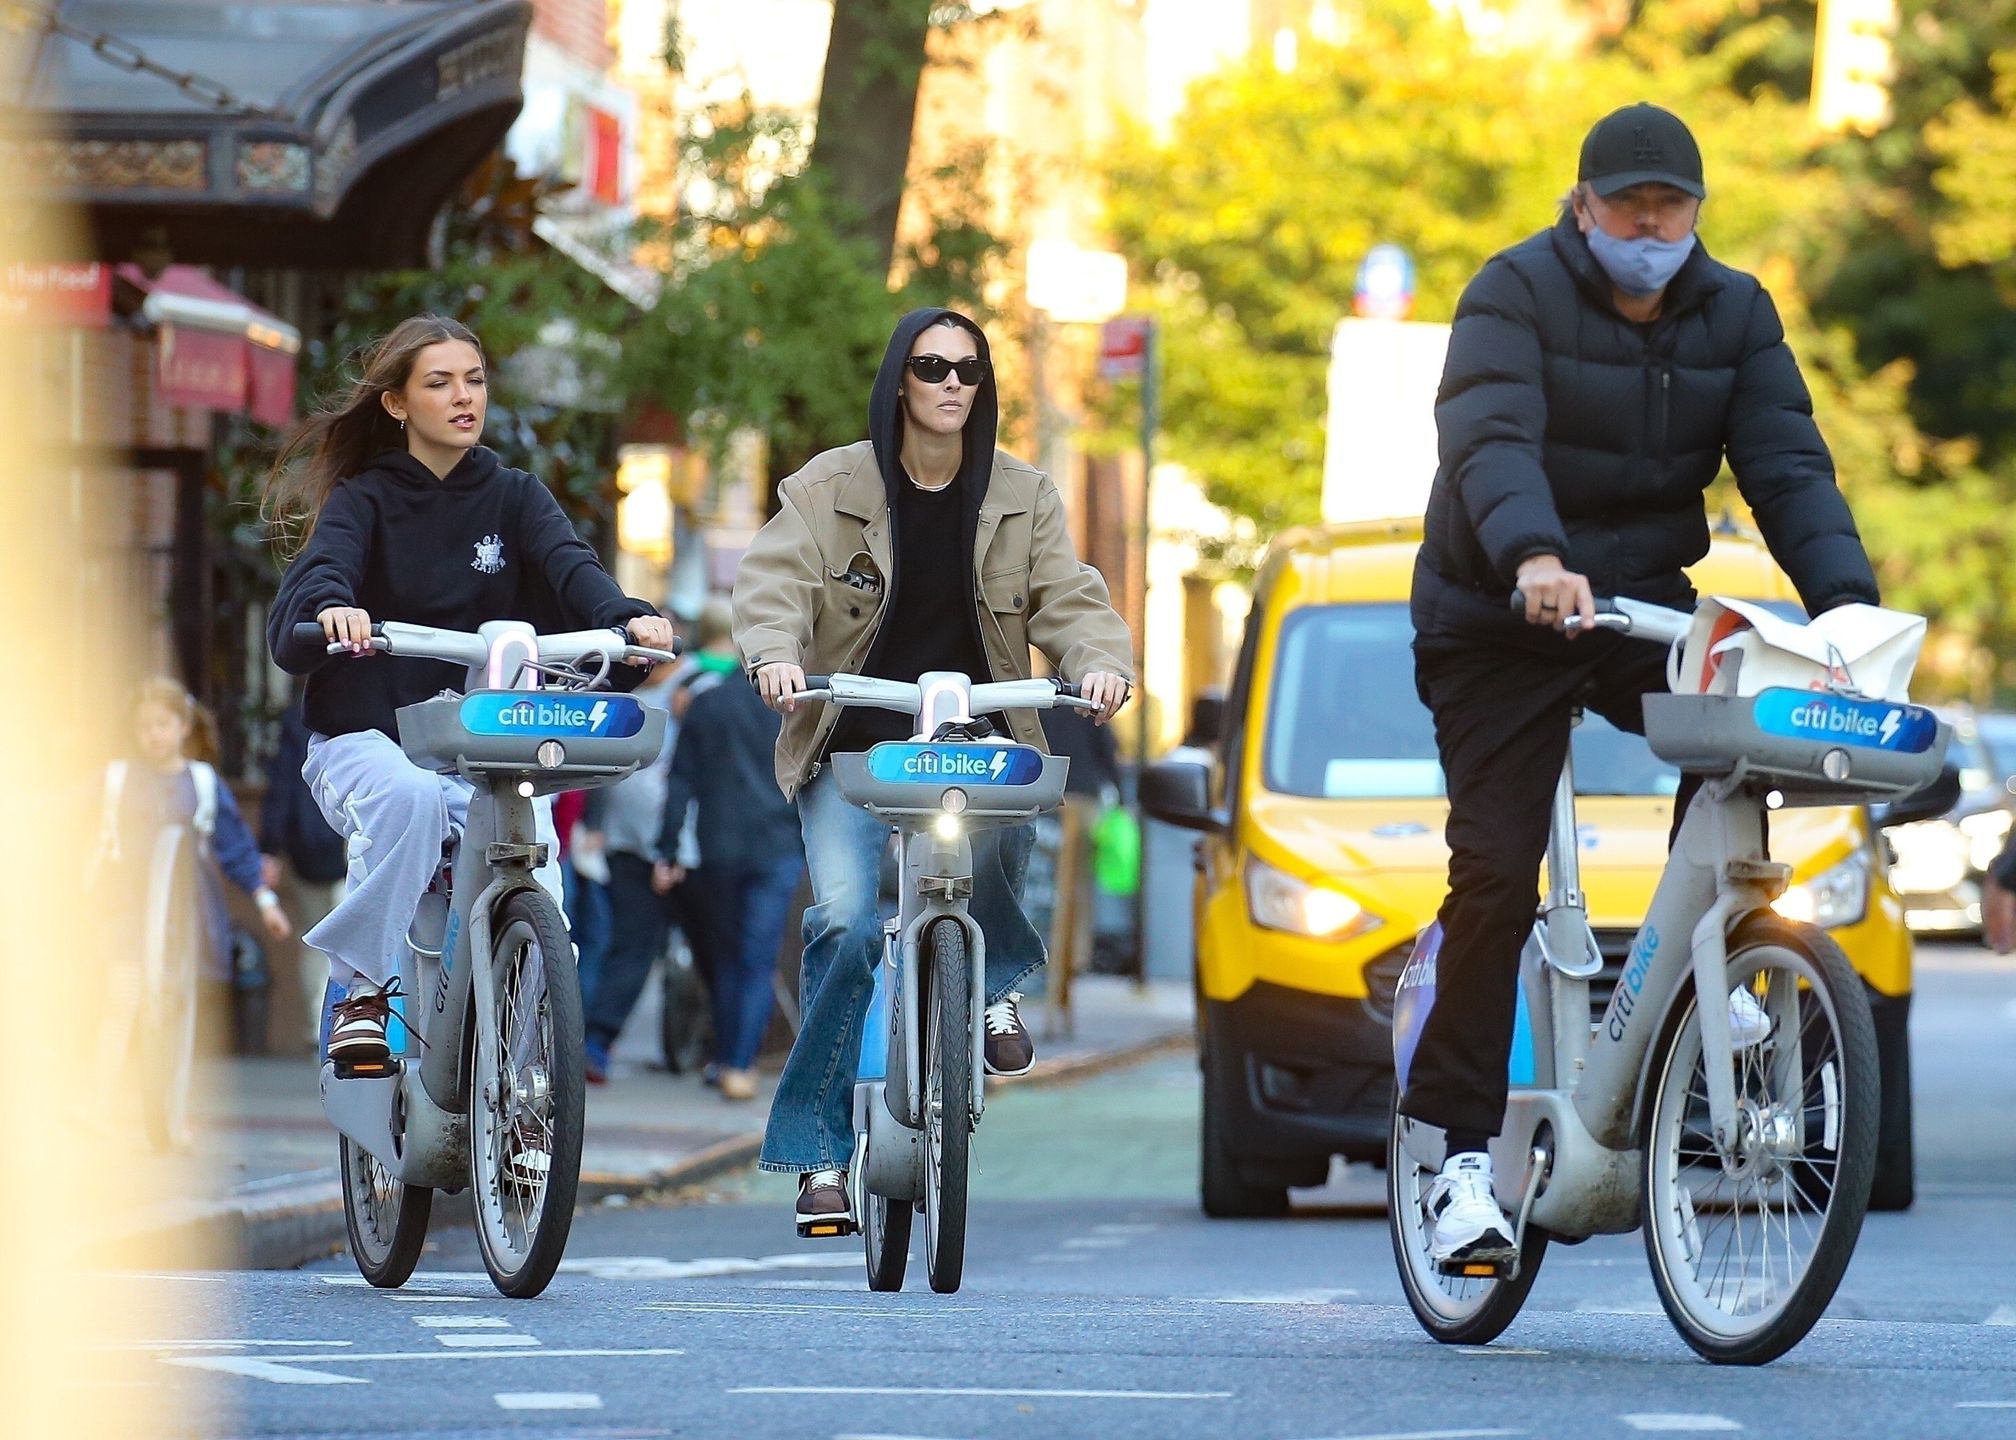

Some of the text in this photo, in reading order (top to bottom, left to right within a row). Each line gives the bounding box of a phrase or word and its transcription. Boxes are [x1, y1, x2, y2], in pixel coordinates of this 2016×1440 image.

[498, 703, 587, 726] citi bike
[1790, 704, 1879, 737] citi bike
[903, 753, 986, 775] citi bike
[435, 907, 460, 1014] citi bike
[1609, 925, 1660, 1042] citi bike
